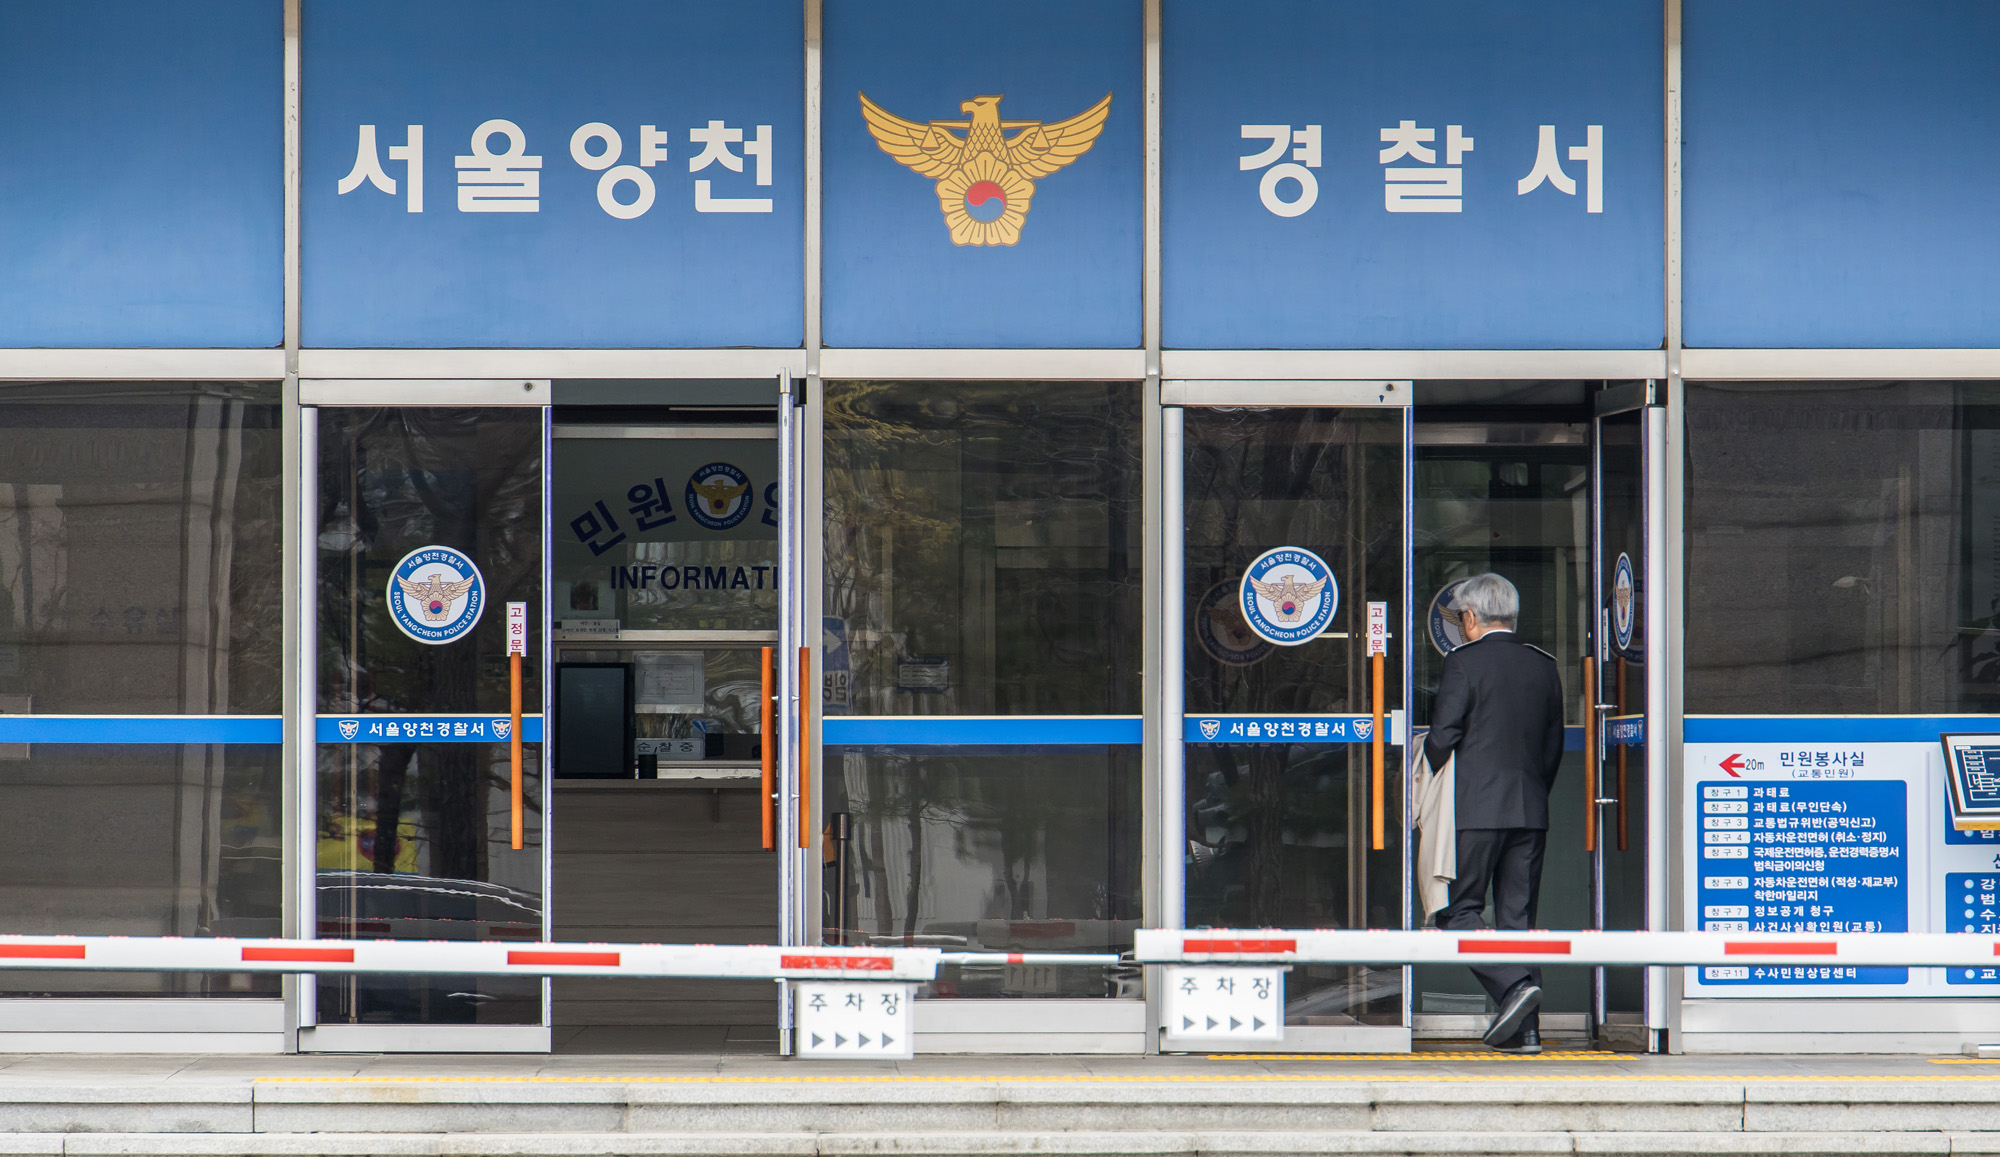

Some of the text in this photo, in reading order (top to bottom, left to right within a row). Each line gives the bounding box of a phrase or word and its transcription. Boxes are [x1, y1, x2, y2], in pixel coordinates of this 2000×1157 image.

[338, 119, 1603, 219] 서울양천 경찰서
[569, 478, 677, 557] 민원
[407, 552, 464, 570] 서울양천경찰서
[1260, 553, 1317, 571] 서울양천경찰서
[394, 590, 479, 638] SEOUL YANGCHEON POLICE STATION
[1247, 591, 1331, 638] SEOUL YANGCHEON POLICE STATION
[510, 607, 523, 650] 고정문
[1371, 607, 1383, 650] 고정문
[369, 721, 484, 737] 서울양천경찰서
[1230, 721, 1345, 737] 서울양천경찰서
[1745, 758, 1765, 771] 20m
[1780, 751, 1865, 768] 민원봉사실
[1791, 768, 1855, 779] (교통민원)
[1753, 786, 1790, 798] 과태료
[1753, 801, 1847, 813] 과태료(무인단속)
[1753, 817, 1876, 829] 교통법규위반(공익신고)
[1754, 832, 1829, 843] 자동차운전면허
[1754, 860, 1825, 872] 범칙금이의신청
[1754, 876, 1829, 888] 자동차운전면허
[1980, 878, 2000, 890] 강
[1754, 890, 1818, 902] 착한마일리지
[1980, 893, 2000, 905] 범
[1755, 905, 1804, 917] 정보공개
[1810, 905, 1834, 917] 청구
[1980, 908, 2000, 921] 수
[1755, 967, 1857, 979] 수사민원상담센터
[1980, 969, 2000, 980] 교
[1179, 976, 1273, 1000] 주차장
[807, 992, 901, 1016] 주차장
